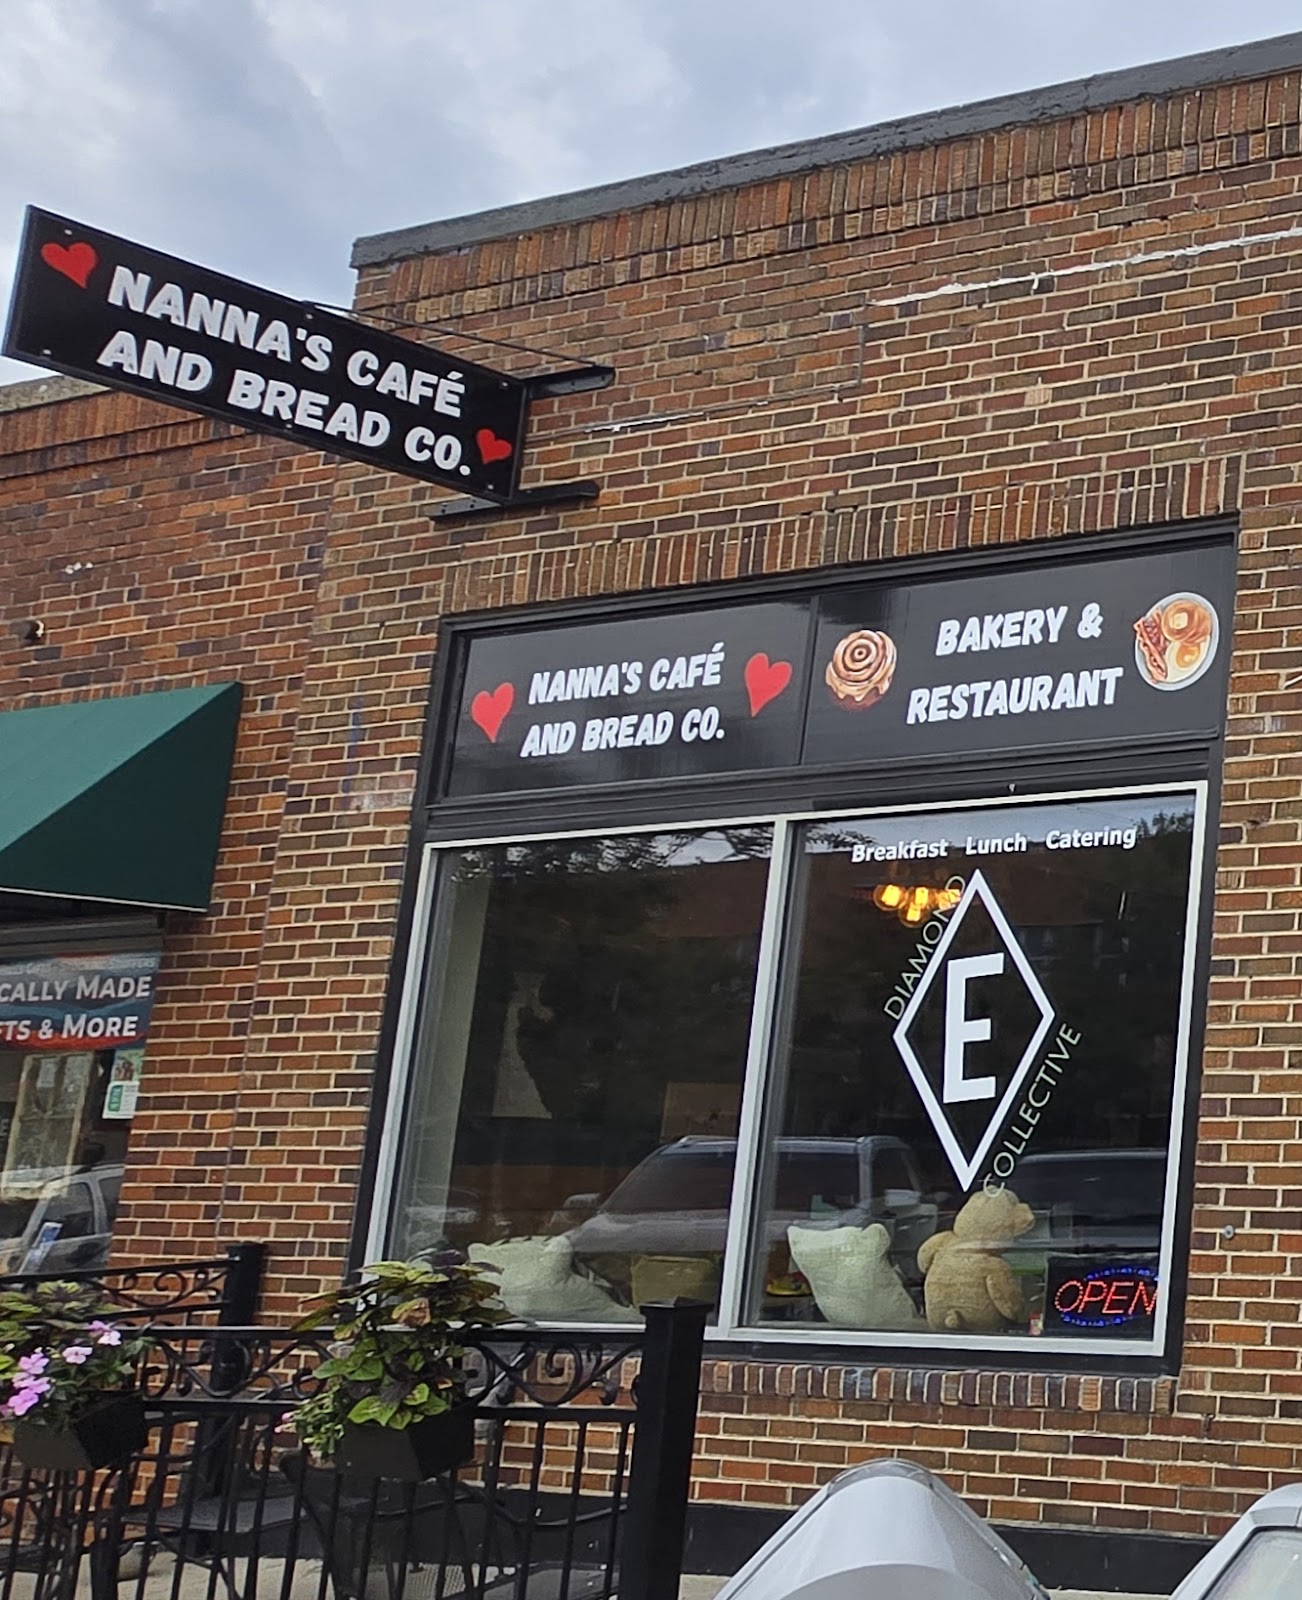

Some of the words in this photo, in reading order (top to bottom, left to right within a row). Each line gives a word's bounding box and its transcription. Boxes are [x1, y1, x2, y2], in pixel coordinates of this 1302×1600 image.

[108, 265, 333, 372] NANNA'S
[346, 349, 466, 418] CAFÉ
[97, 331, 214, 392] AND
[227, 369, 391, 448] BREAD
[404, 426, 472, 476] CO.
[936, 605, 1064, 656] BAKERY
[1077, 601, 1102, 638] &
[528, 660, 640, 705] NANNA'S
[649, 643, 725, 692] CAFÉ
[907, 667, 1124, 725] RESTAURANT
[520, 721, 576, 759] AND
[582, 714, 671, 754] BREAD
[680, 709, 725, 743] CO.
[851, 837, 948, 863] Breakfast
[966, 832, 1027, 856] Lunch
[1046, 825, 1137, 851] Catering
[884, 875, 966, 1021] DIAMOND
[76, 975, 151, 1000] MADE
[0, 1019, 31, 1041] TS
[38, 1019, 53, 1039] &
[62, 1013, 139, 1039] MORE
[943, 952, 1004, 1104] E
[983, 1023, 1082, 1197] COLLECTIVE
[1054, 1279, 1158, 1316] OPEN
